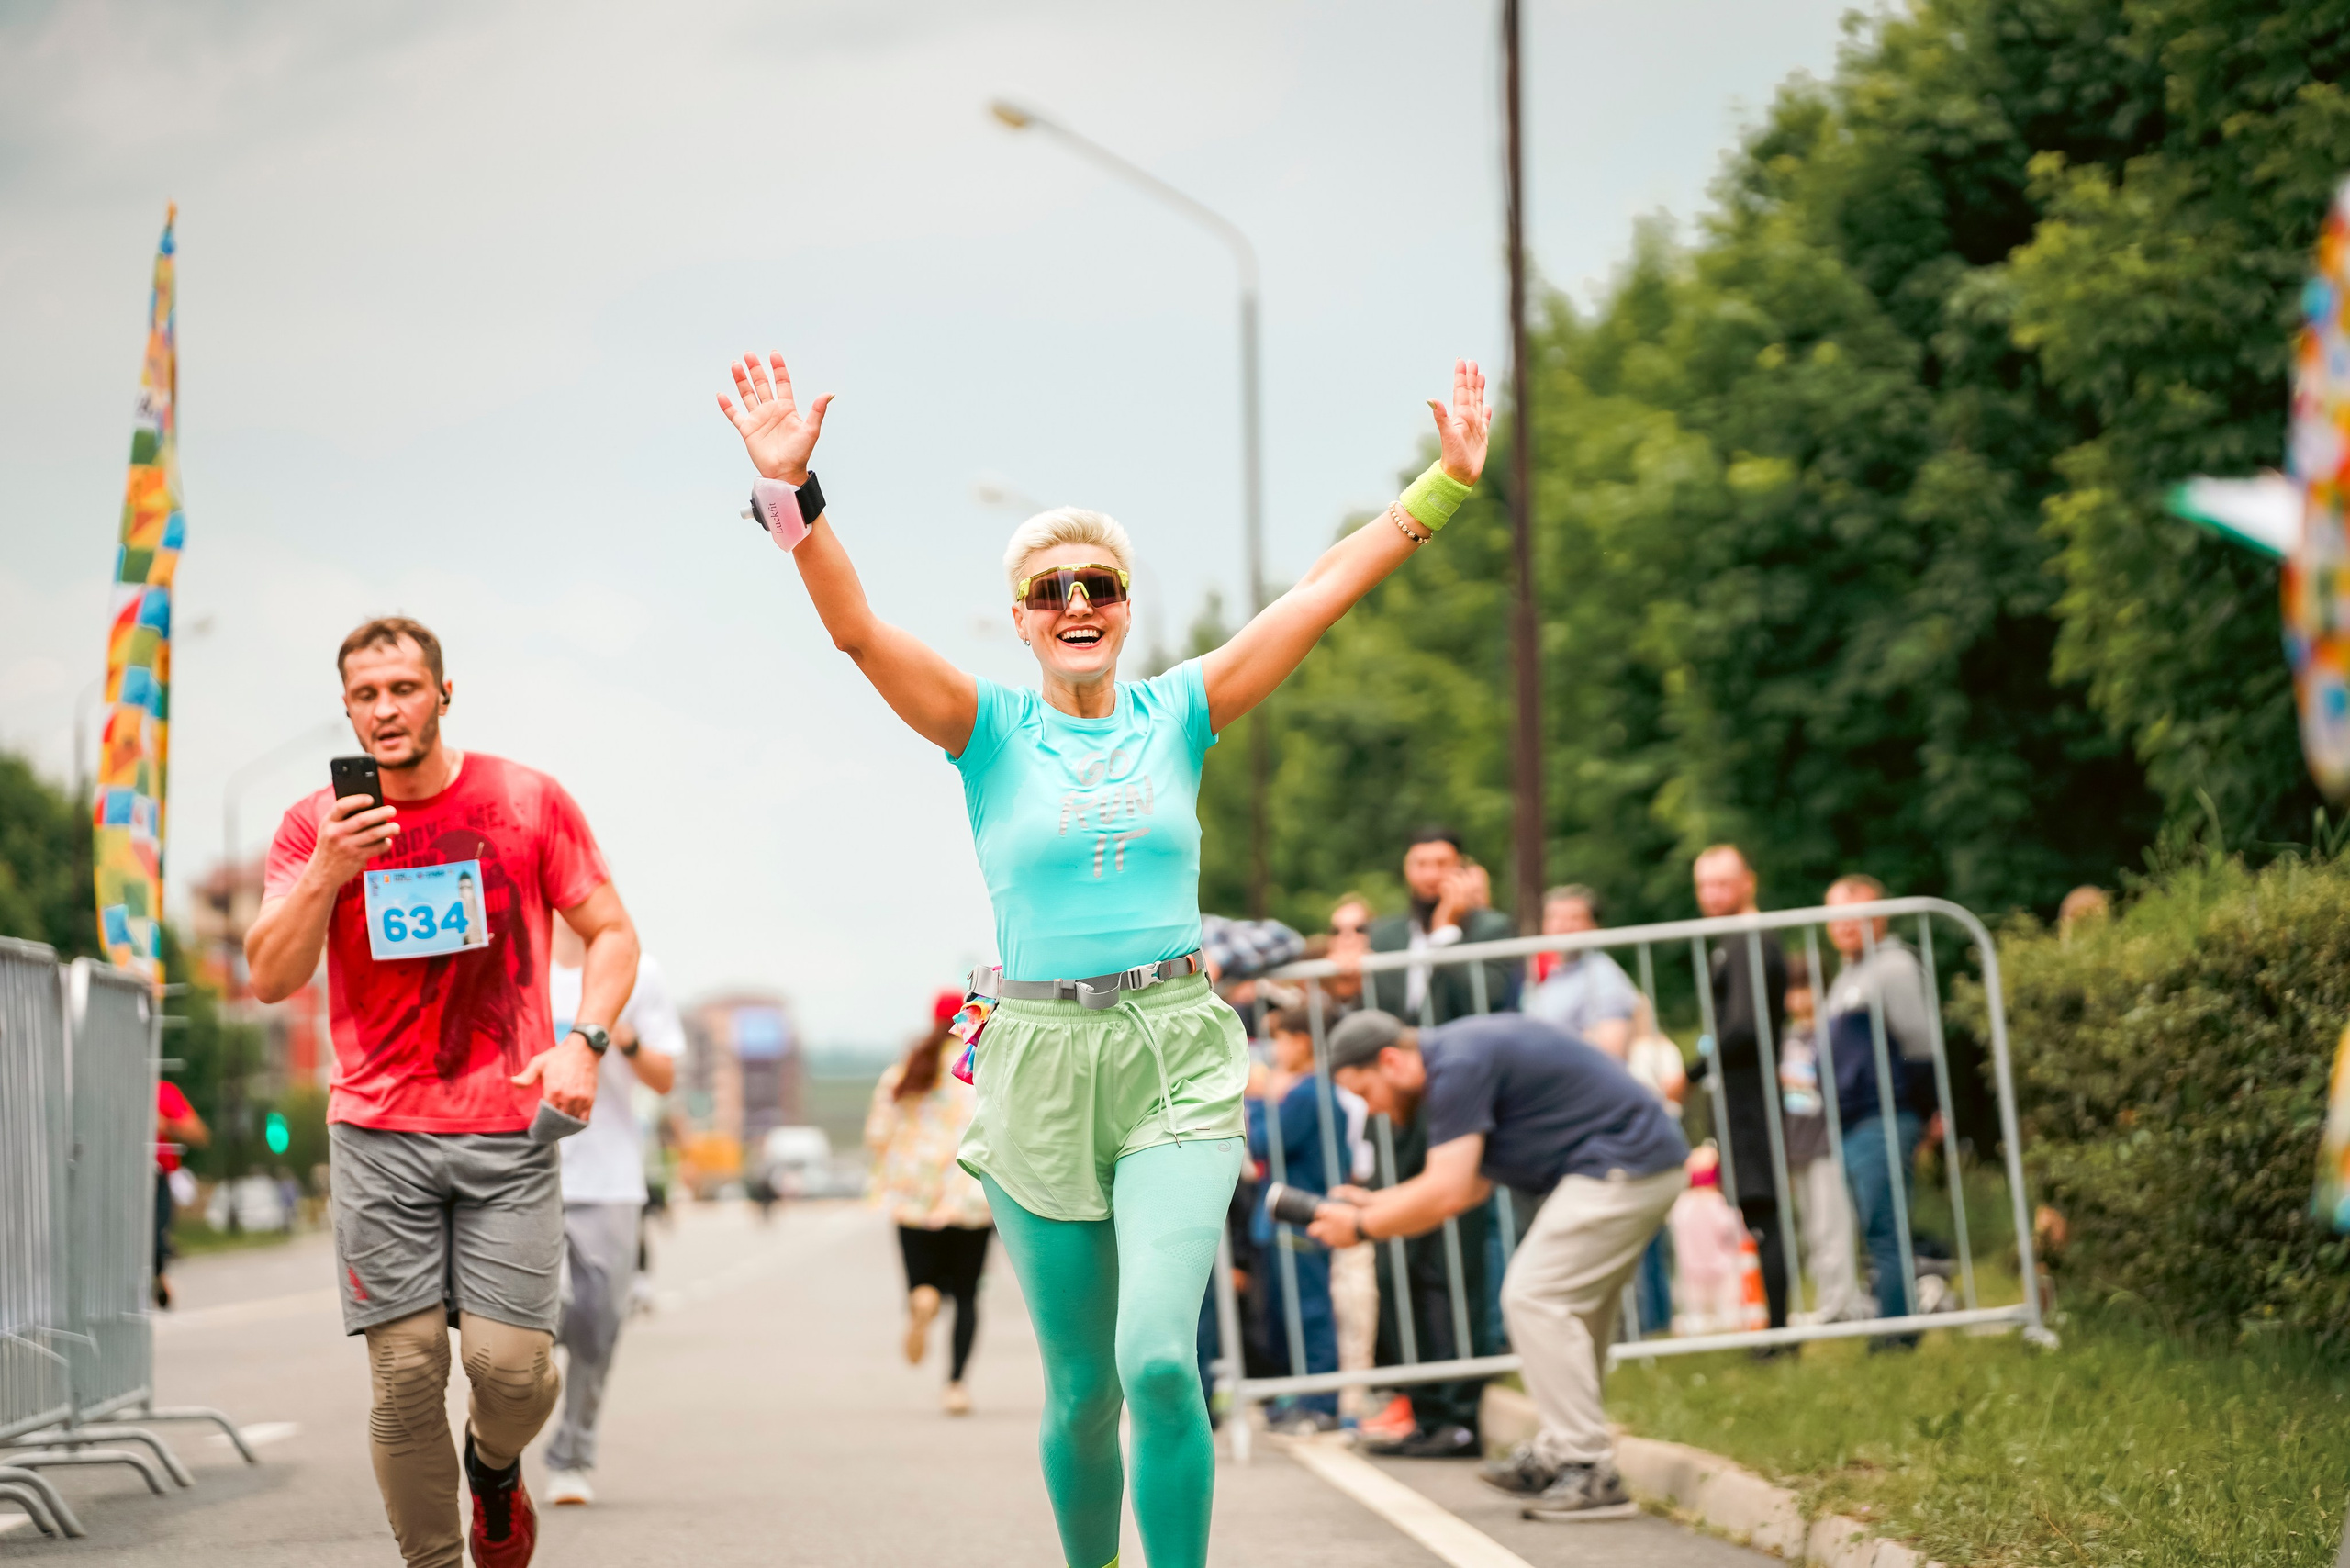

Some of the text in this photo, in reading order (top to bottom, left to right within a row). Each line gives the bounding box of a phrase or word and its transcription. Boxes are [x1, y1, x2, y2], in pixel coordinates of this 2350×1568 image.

[1077, 749, 1130, 787] GO
[1058, 775, 1154, 836] RUN
[1093, 827, 1151, 879] IT
[383, 901, 469, 943] 634
